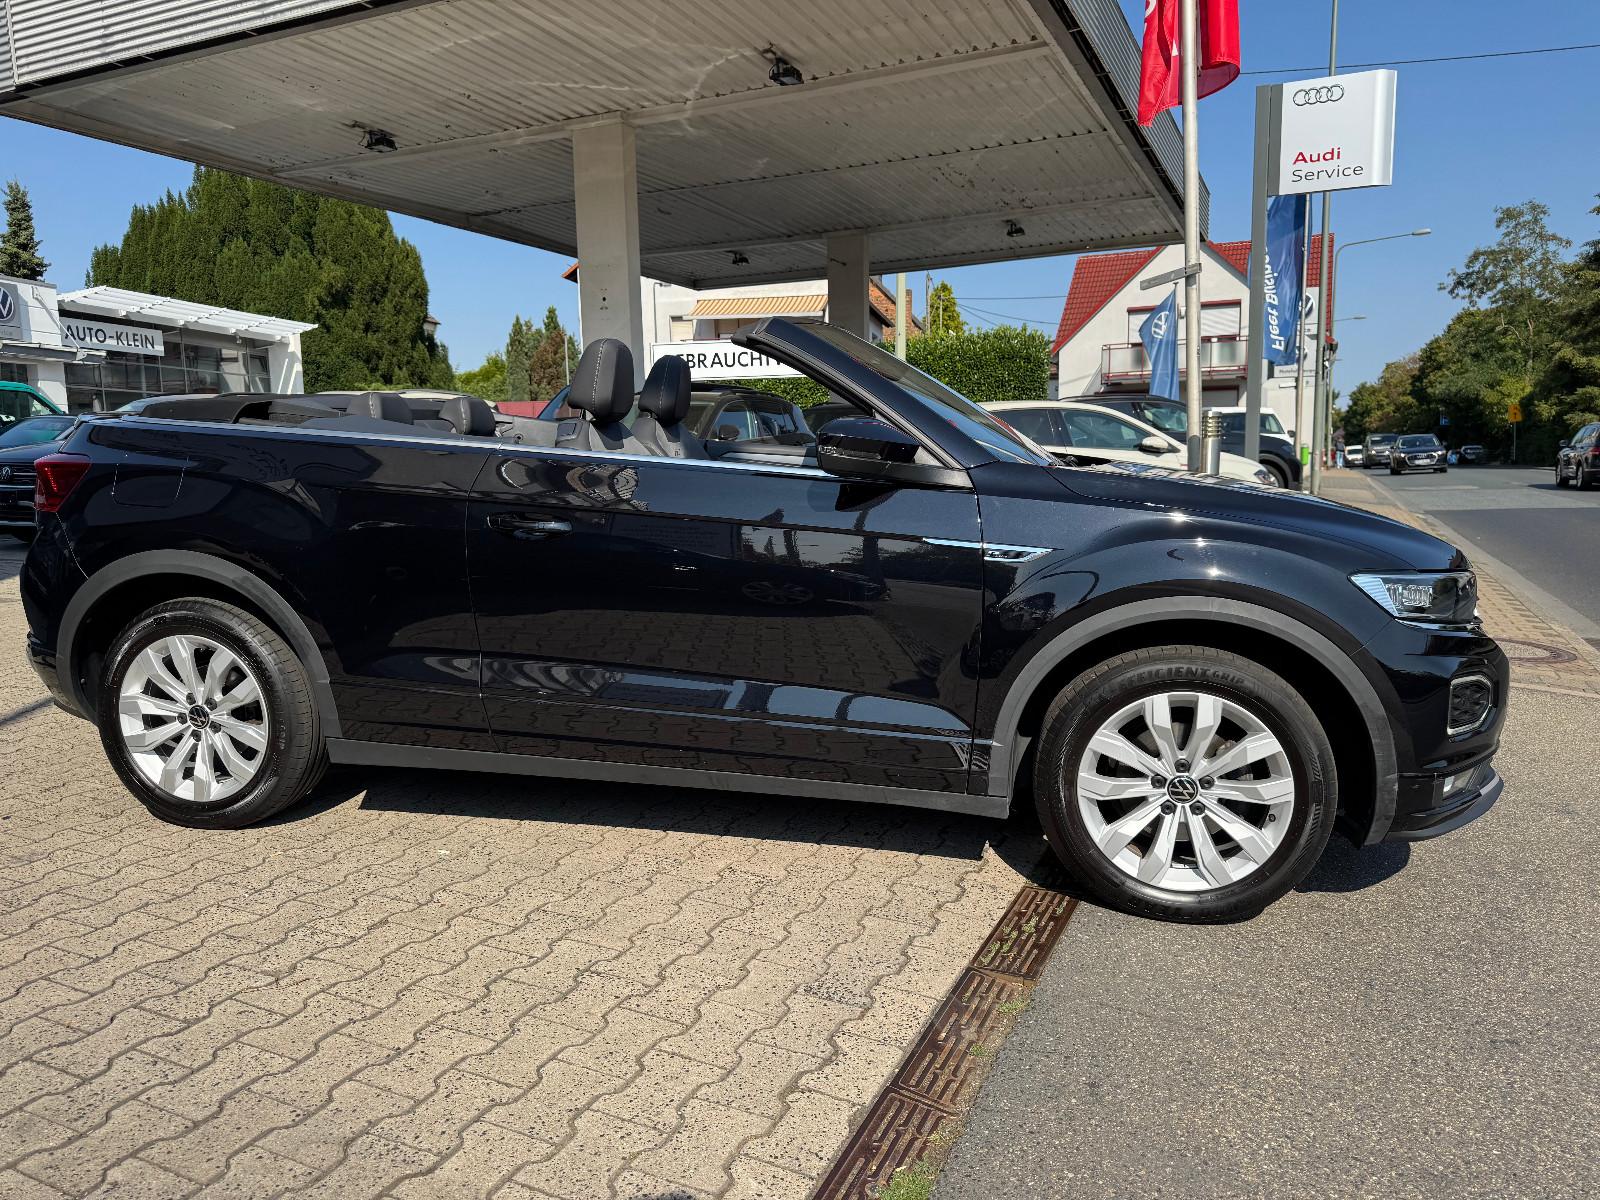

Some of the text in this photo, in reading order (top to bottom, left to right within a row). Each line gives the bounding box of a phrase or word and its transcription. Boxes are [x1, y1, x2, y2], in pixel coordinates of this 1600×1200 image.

[1293, 147, 1341, 164] Audi
[1292, 165, 1364, 182] Service
[64, 325, 155, 349] AUTO-KLEIN
[676, 352, 781, 369] BRAUCHT
